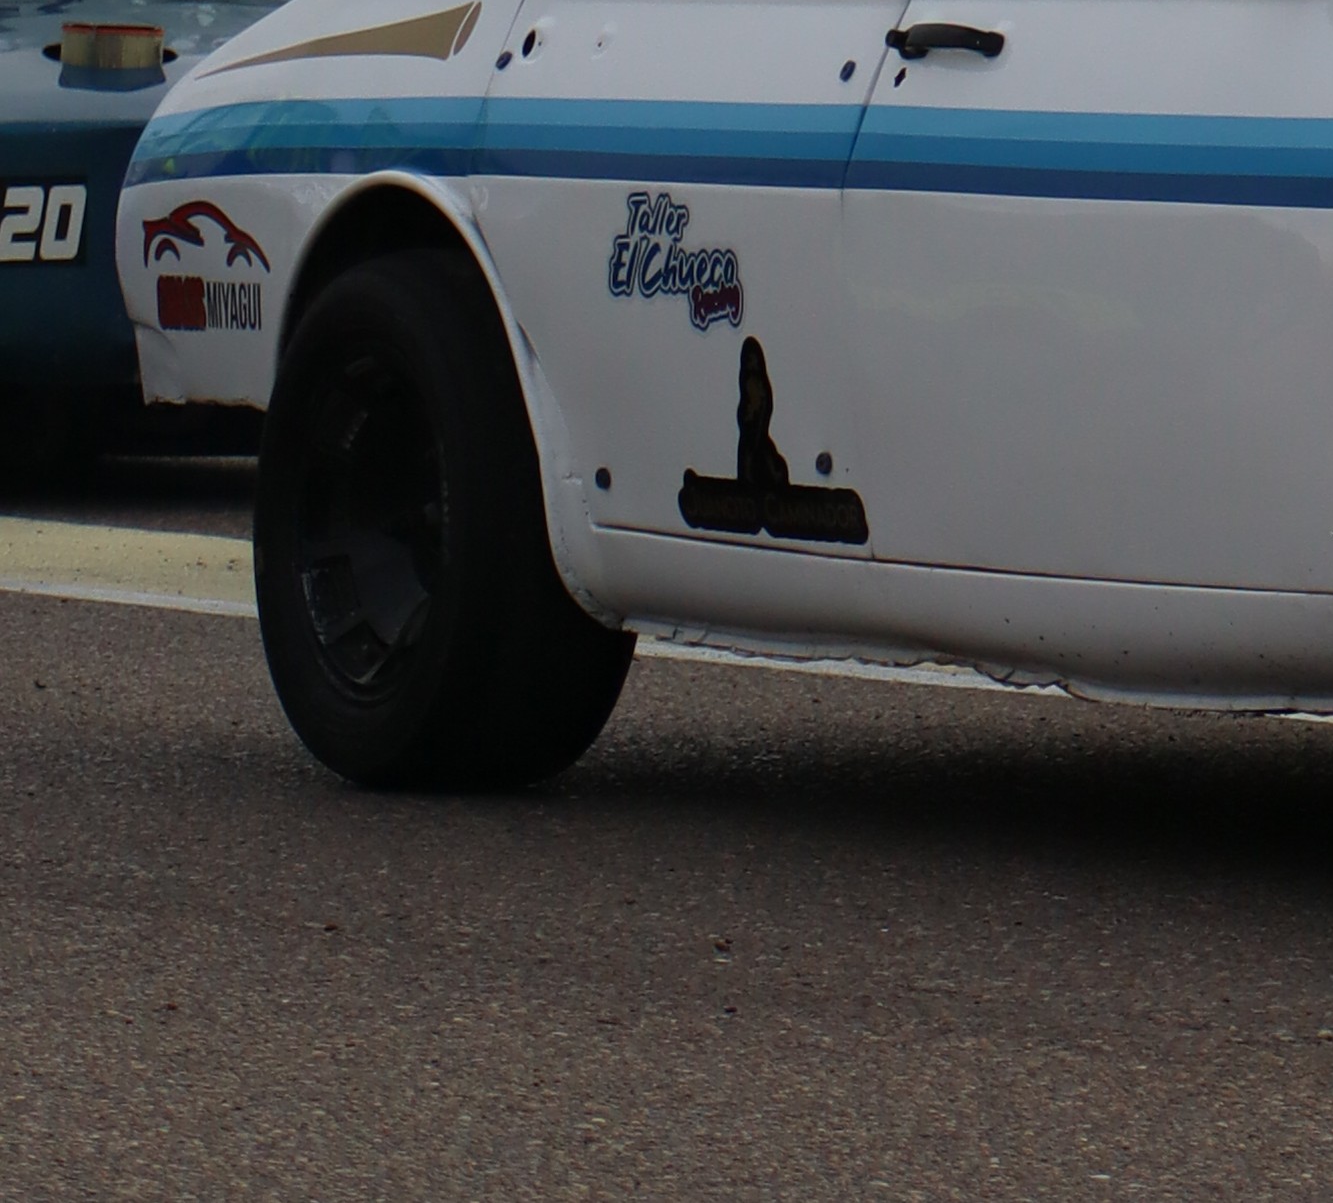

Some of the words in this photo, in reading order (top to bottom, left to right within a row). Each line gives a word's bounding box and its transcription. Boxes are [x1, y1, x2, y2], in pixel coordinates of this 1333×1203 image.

[628, 192, 689, 239] Taller
[611, 236, 638, 294] El
[206, 282, 262, 331] MIYAGUI
